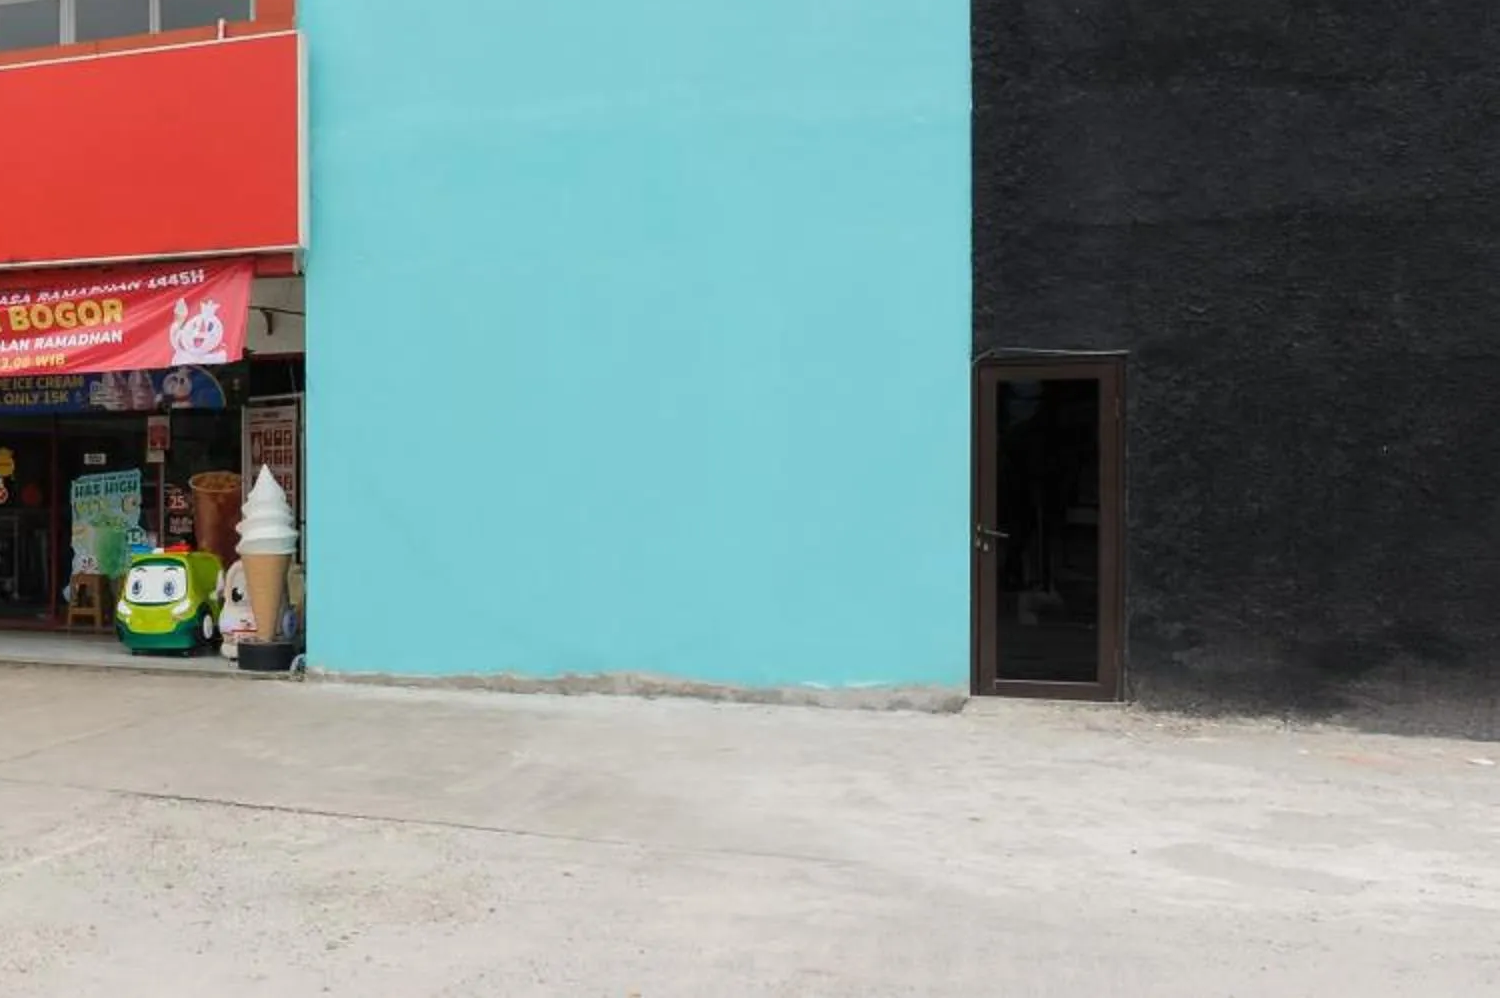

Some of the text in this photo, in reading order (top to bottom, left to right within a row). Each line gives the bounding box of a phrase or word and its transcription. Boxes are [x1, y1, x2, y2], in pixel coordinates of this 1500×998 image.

[147, 269, 204, 289] 1445H
[10, 299, 123, 331] BOGOR
[34, 331, 123, 350] RAMADHAN
[35, 354, 66, 366] WIB
[13, 376, 33, 389] ICE
[36, 375, 84, 389] CREAM
[3, 391, 39, 404] ONLY
